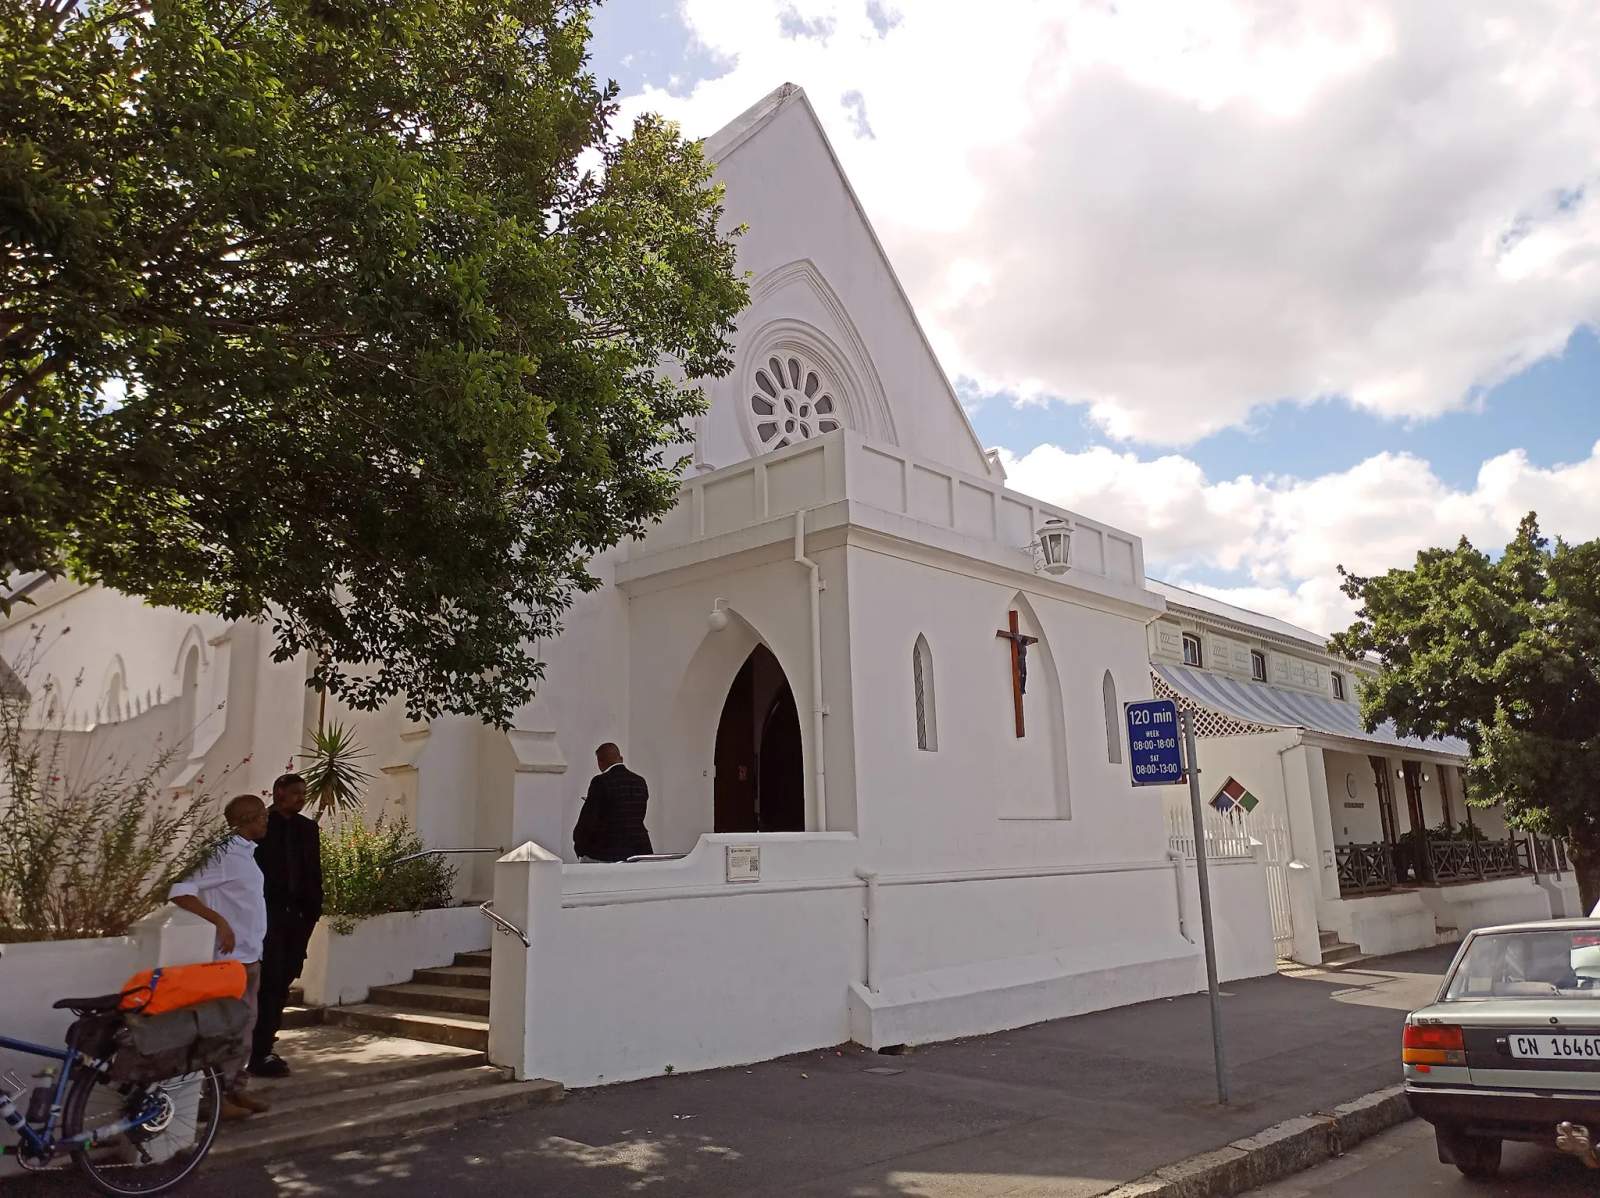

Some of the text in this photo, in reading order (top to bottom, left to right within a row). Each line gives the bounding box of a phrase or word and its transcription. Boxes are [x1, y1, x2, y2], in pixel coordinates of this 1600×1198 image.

[1130, 708, 1172, 725] 120 min
[1145, 730, 1160, 738] WEEK
[1518, 1038, 1539, 1055] CN
